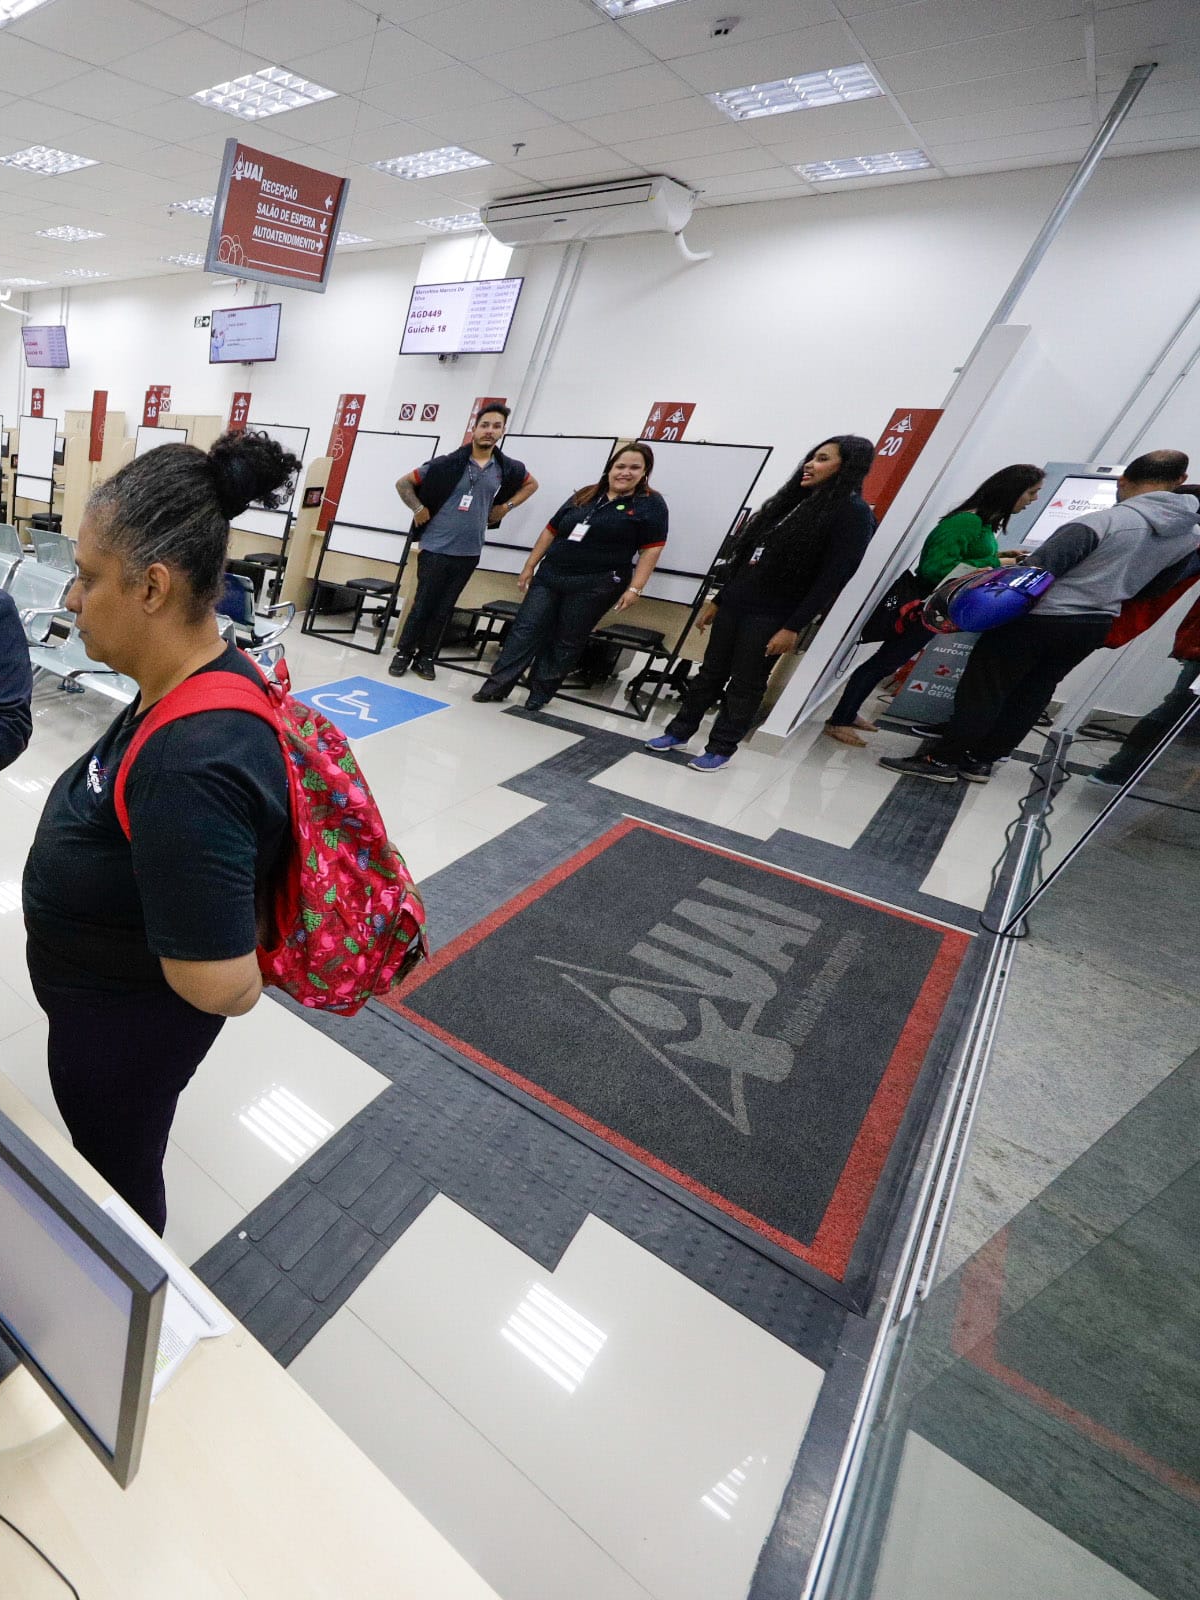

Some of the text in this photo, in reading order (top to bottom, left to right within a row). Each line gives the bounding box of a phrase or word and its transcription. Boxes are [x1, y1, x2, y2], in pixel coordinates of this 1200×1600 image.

[244, 161, 263, 182] UAI
[261, 179, 298, 201] RECEPÇÃO
[256, 202, 316, 229] SALÃO DE ESPERA
[253, 225, 316, 250] AUTOATENDIMENTO
[410, 310, 442, 318] AGD449
[437, 325, 447, 333] 18
[33, 400, 42, 410] 15
[147, 406, 157, 418] 16
[234, 409, 245, 422] 17
[343, 413, 357, 427] 18
[644, 425, 655, 440] 19
[660, 426, 679, 441] 20
[878, 436, 904, 457] 20
[627, 876, 823, 1003] UAI
